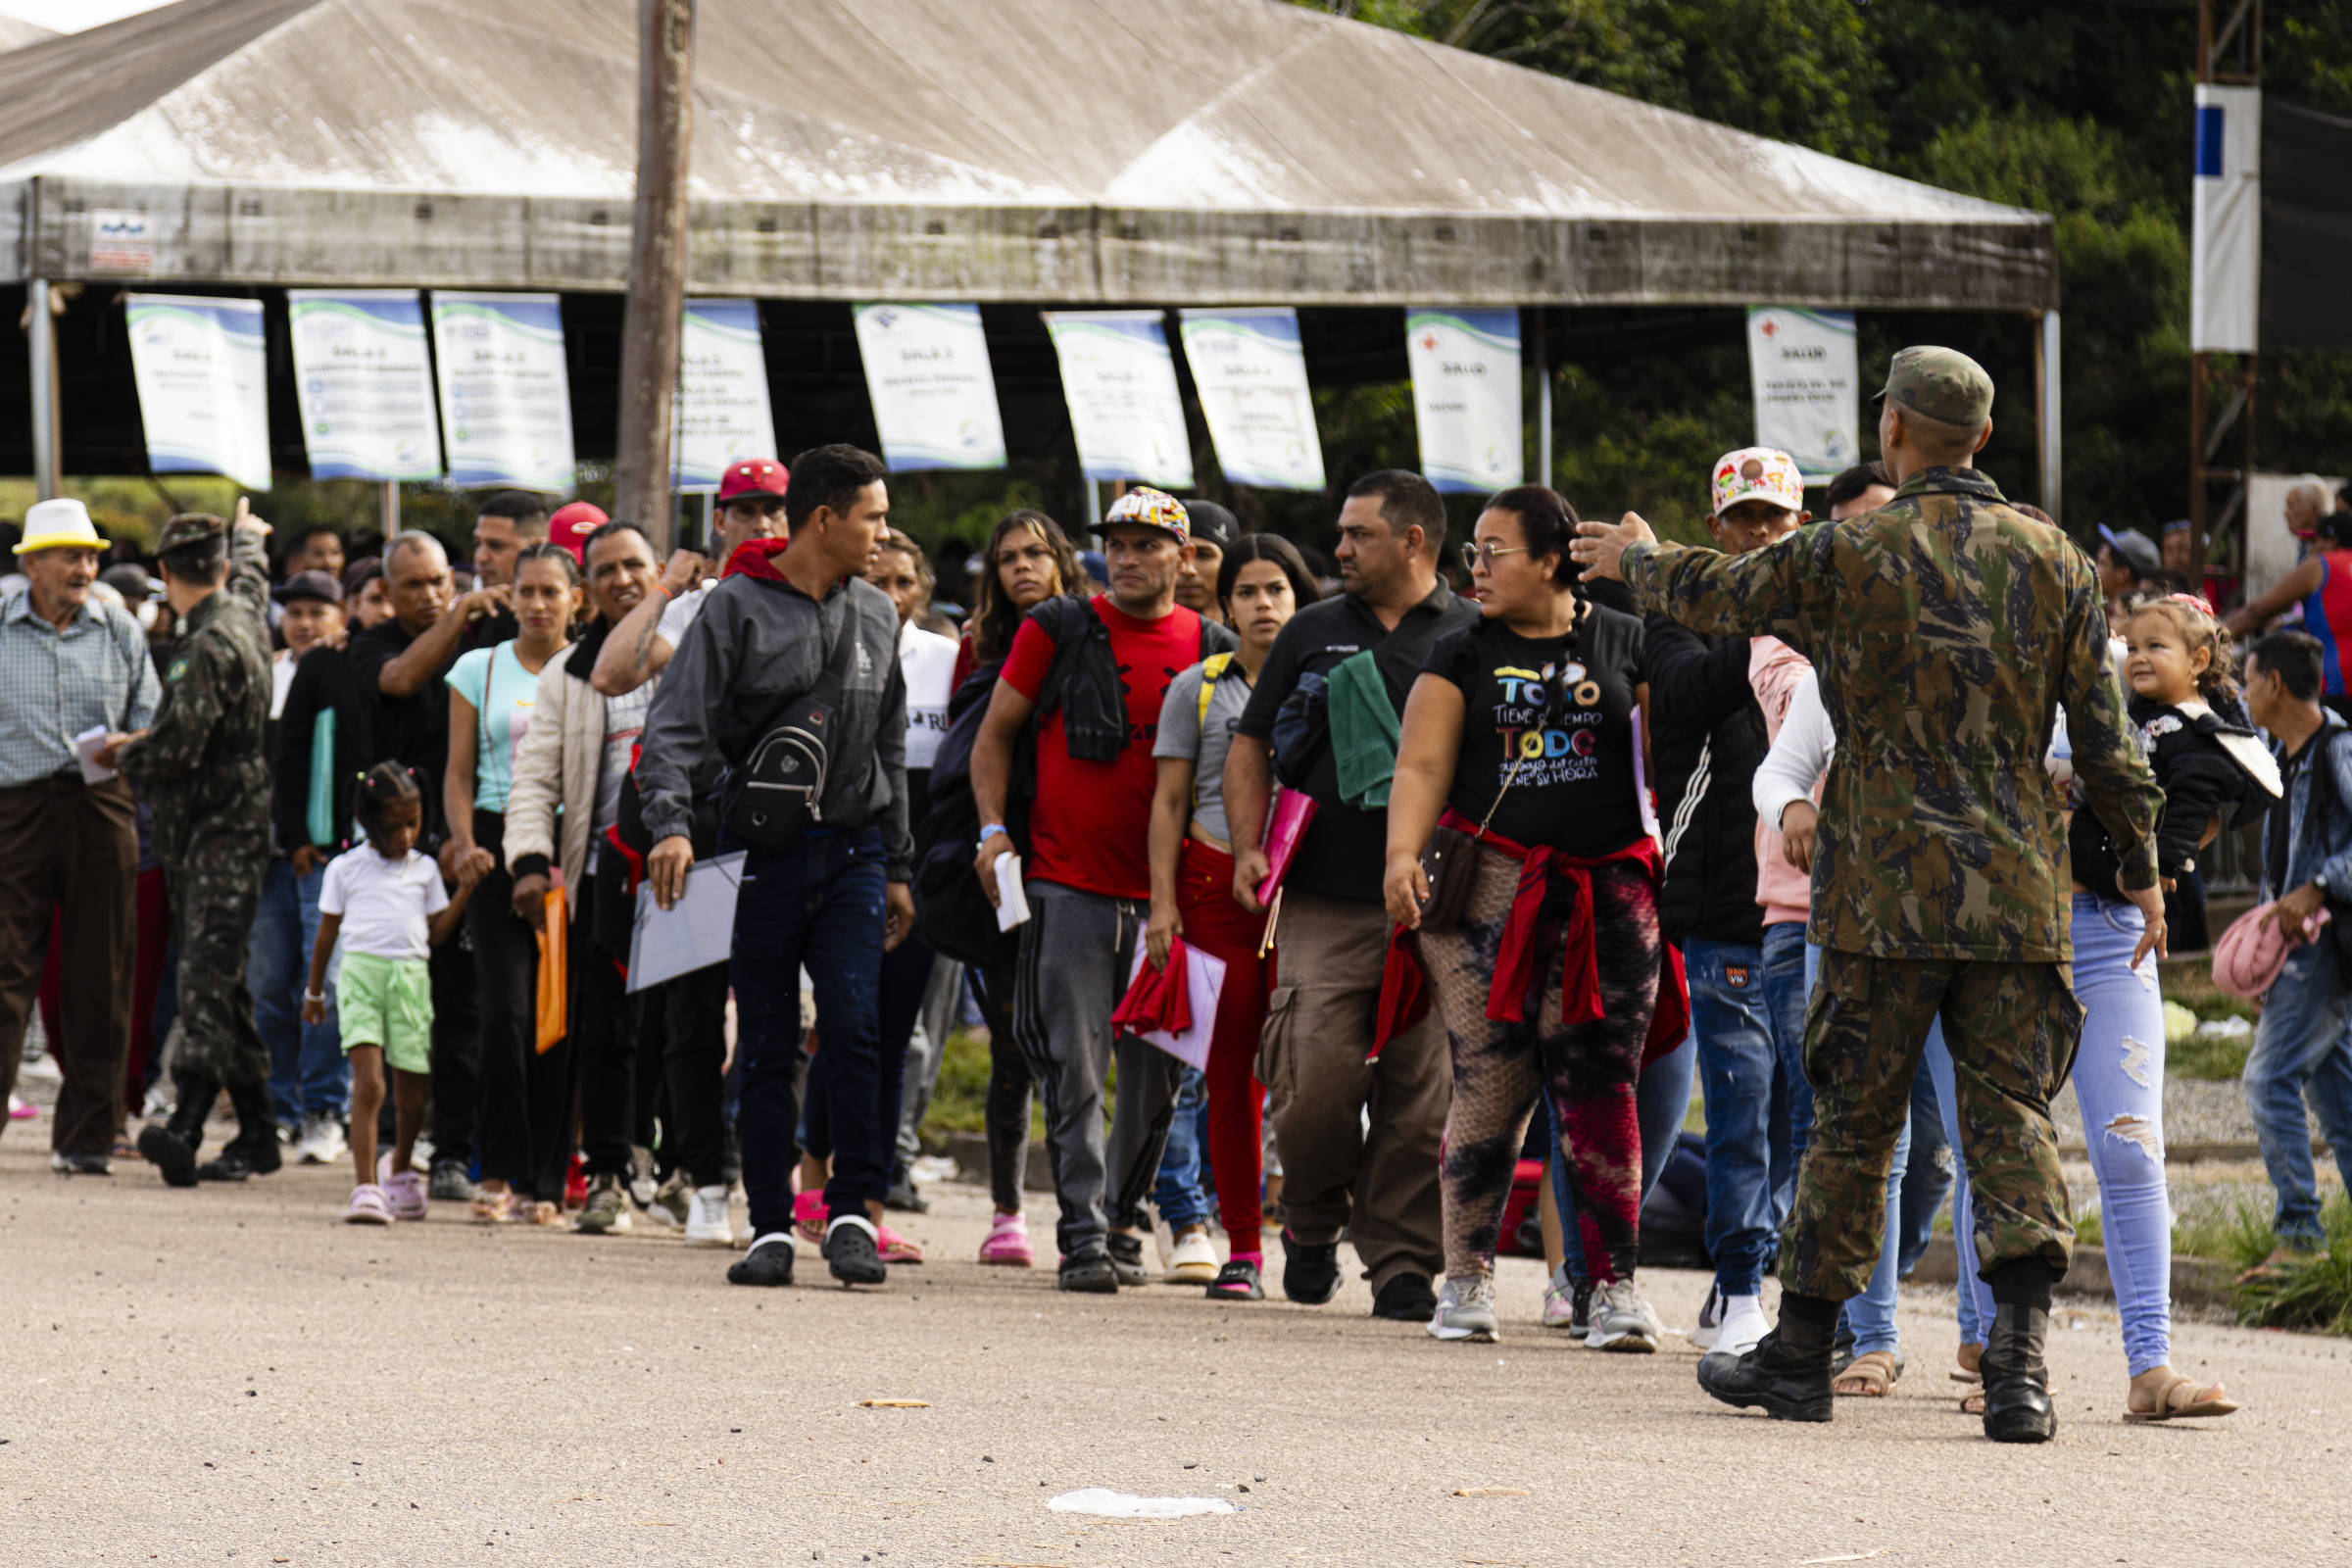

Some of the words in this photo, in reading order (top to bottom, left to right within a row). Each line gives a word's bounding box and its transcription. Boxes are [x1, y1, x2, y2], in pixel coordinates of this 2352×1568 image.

[1782, 346, 1827, 362] SALUD
[1442, 361, 1488, 376] SALUD
[1496, 677, 1601, 706] TOO
[1493, 704, 1535, 724] TIENE
[1563, 711, 1602, 726] EMPO
[1552, 766, 1598, 784] HORA
